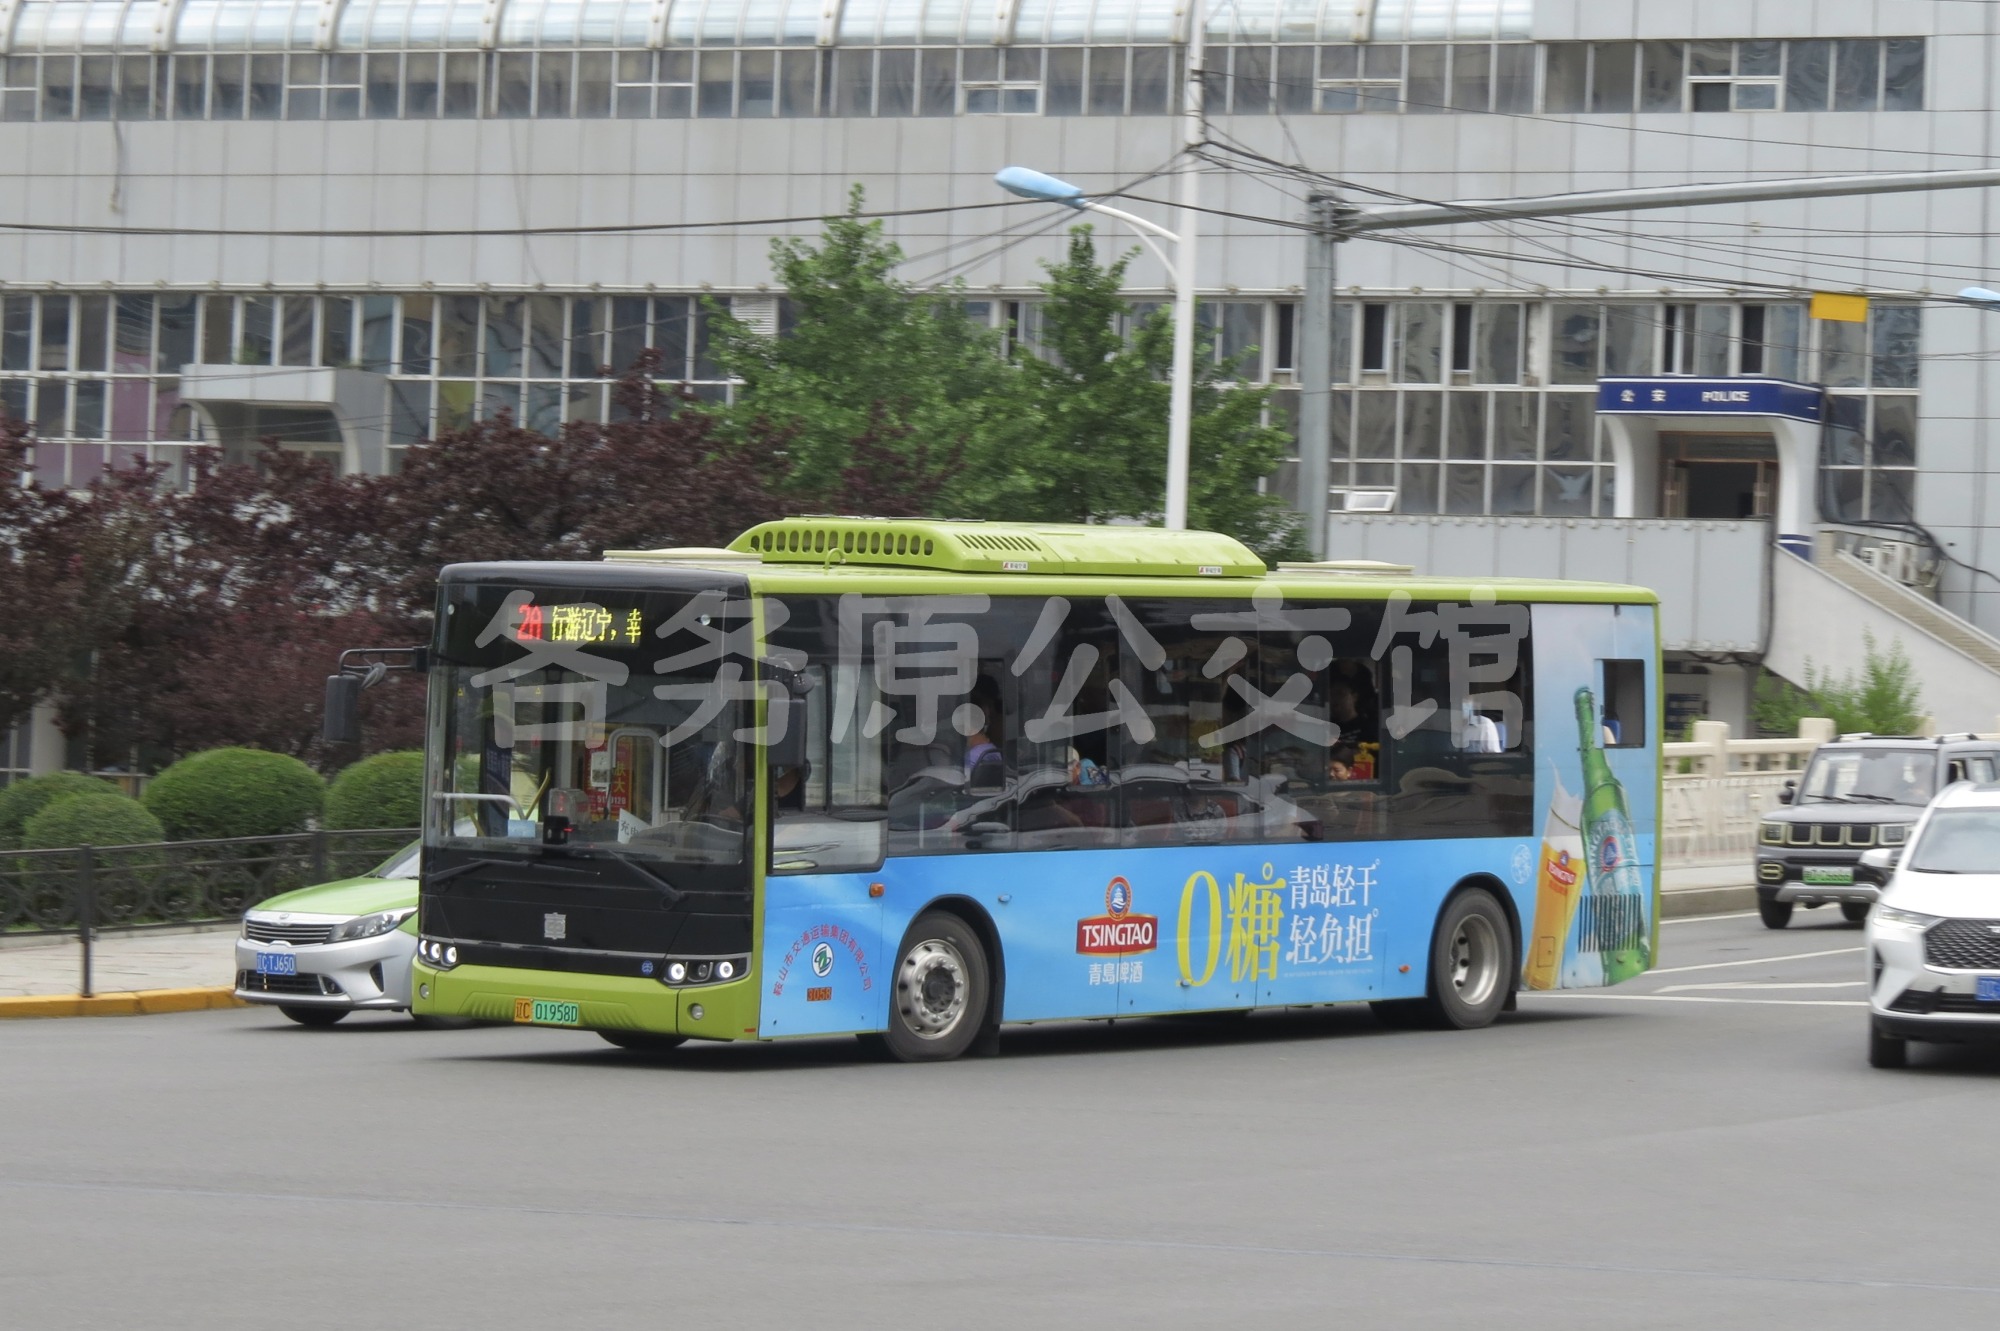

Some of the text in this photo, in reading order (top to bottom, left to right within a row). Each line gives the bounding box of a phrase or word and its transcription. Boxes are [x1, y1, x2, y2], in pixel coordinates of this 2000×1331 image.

[1702, 391, 1750, 402] POLICE
[1082, 922, 1153, 947] TSINGTAO
[1285, 912, 1374, 965] 轻负担
[773, 924, 872, 996] 鞍山市交通运输集团有限公司
